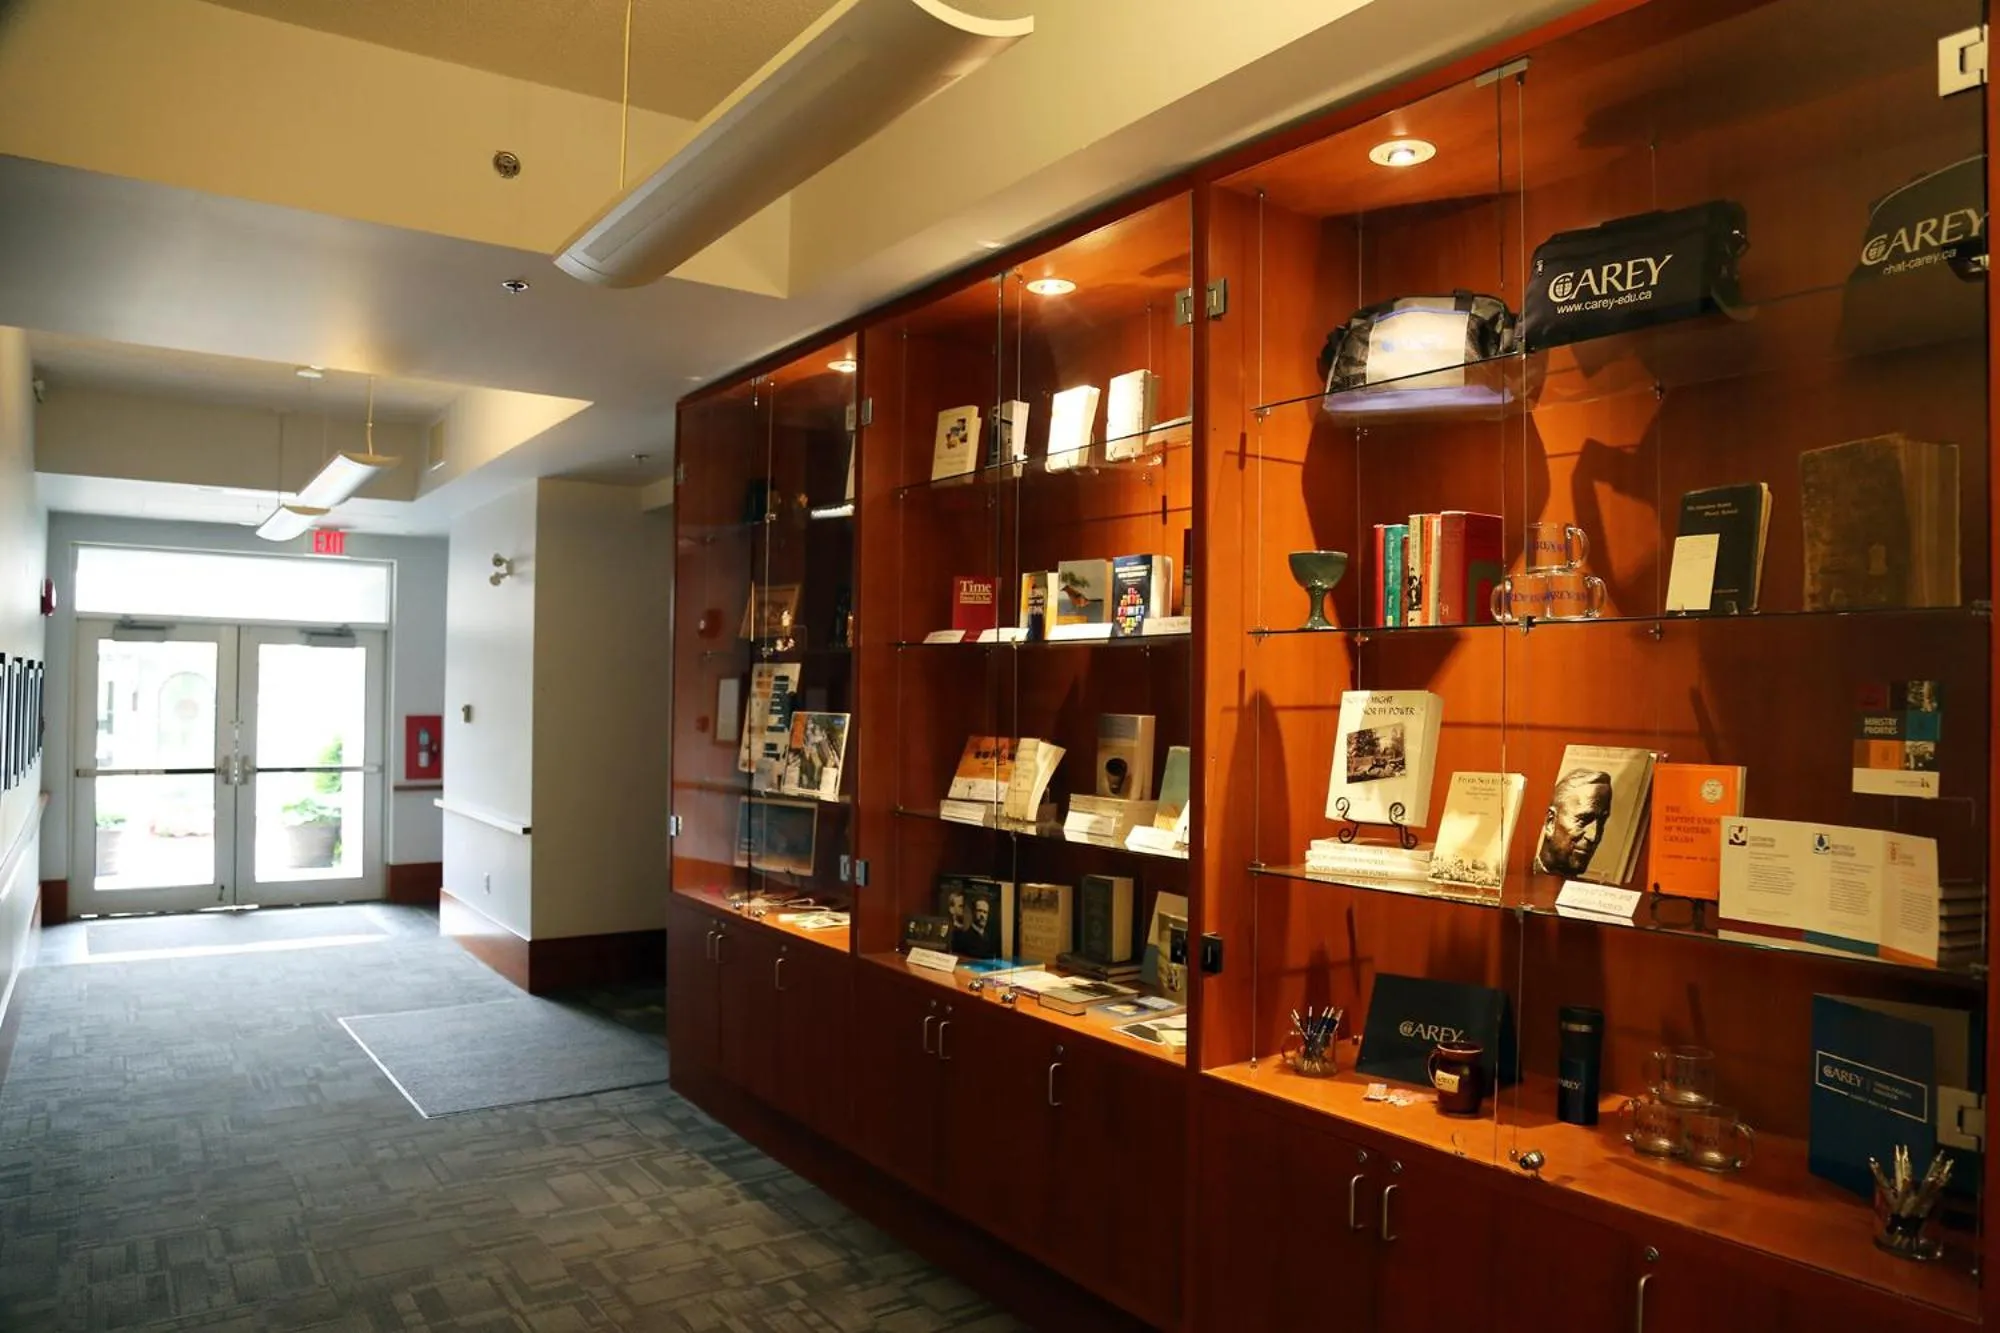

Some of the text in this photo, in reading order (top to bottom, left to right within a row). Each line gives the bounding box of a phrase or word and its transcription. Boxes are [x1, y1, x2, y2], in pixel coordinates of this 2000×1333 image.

[1862, 208, 1989, 266] CAREY
[1548, 254, 1673, 303] CAREY
[1556, 289, 1653, 314] www.carey-edu.ca
[313, 530, 347, 554] EXIT
[959, 580, 992, 593] Time
[1399, 1020, 1464, 1043] CAREY
[1822, 1065, 1864, 1087] CAREY
